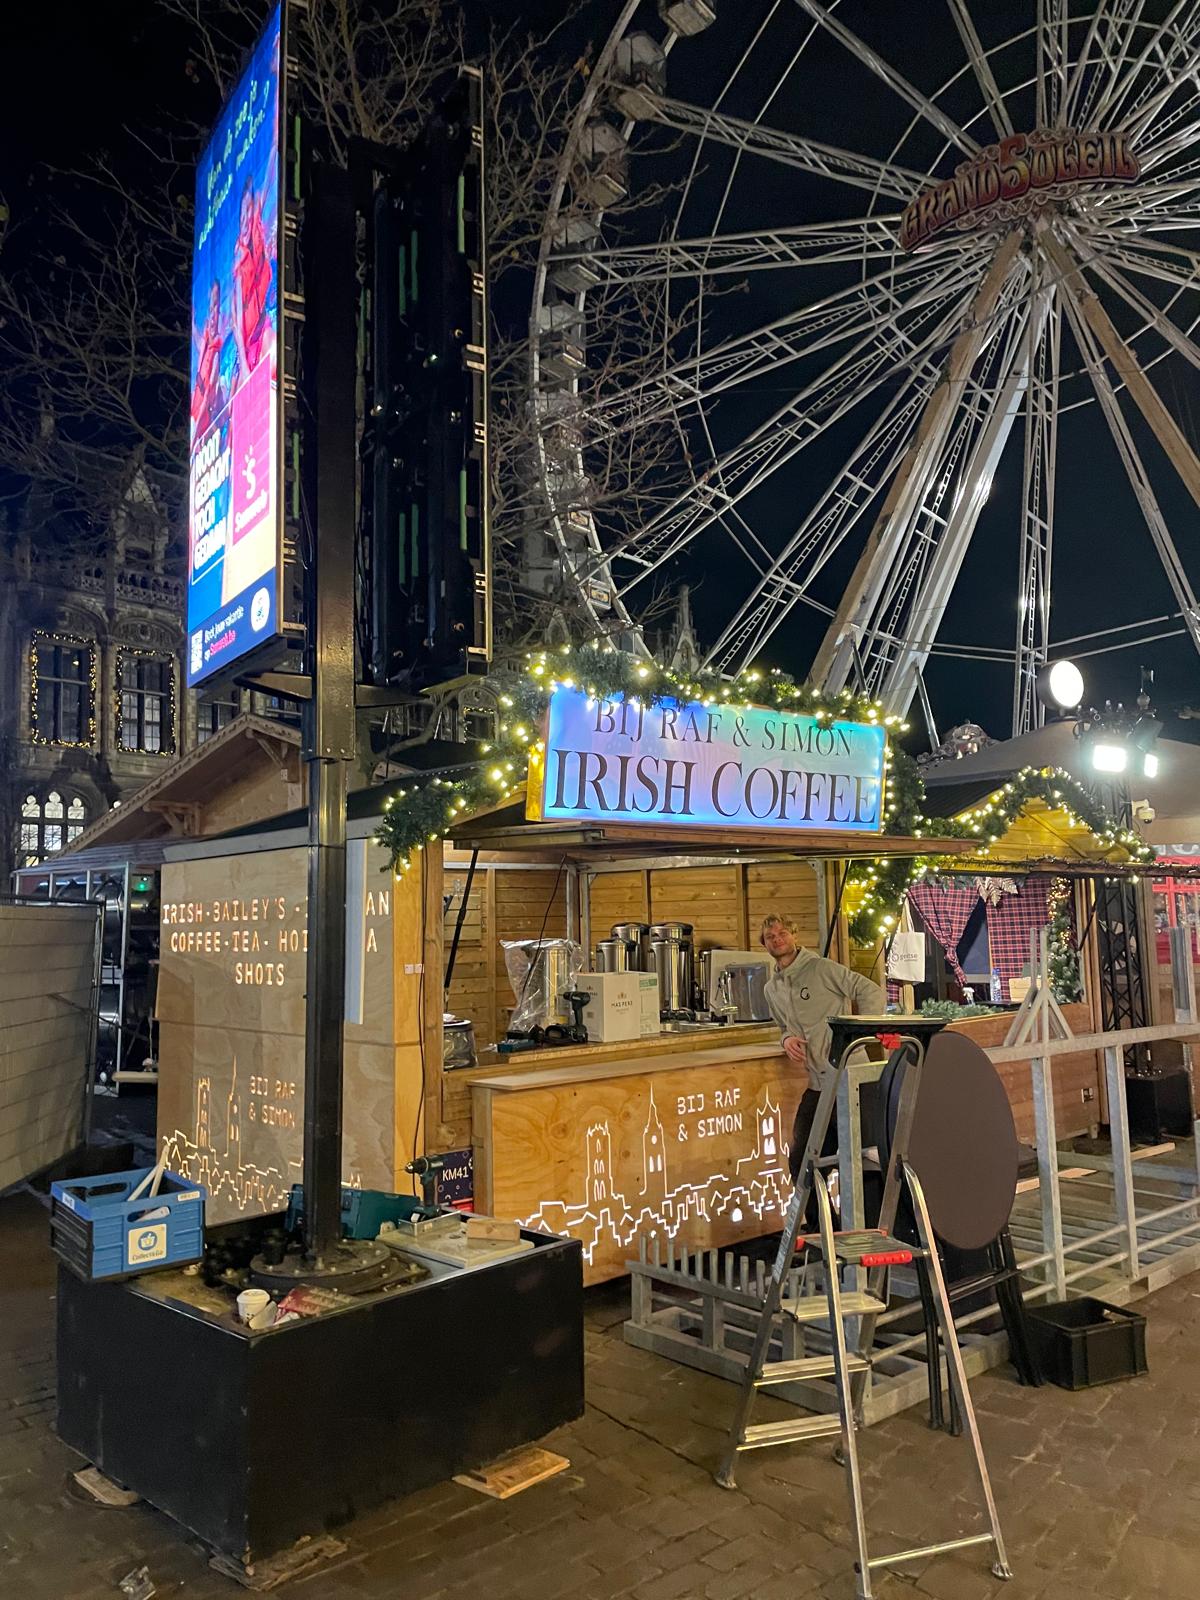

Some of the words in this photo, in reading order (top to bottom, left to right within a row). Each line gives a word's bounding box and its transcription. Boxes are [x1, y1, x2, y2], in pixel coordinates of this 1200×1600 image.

[900, 160, 1001, 251] GRAND
[1001, 133, 1141, 200] SOLEIL
[195, 428, 221, 482] NOOIT
[593, 699, 643, 742] BIJ
[659, 706, 724, 745] RAF
[732, 716, 752, 747] &
[761, 718, 855, 758] SIMON
[549, 748, 699, 816] IRISH
[710, 761, 877, 824] COFFEE
[235, 962, 286, 986] SHOTS
[262, 1104, 295, 1128] SIMON
[677, 1093, 705, 1115] BIJ
[714, 1087, 741, 1109] RAF
[678, 1123, 689, 1142] &
[697, 1112, 743, 1138] SIMON
[442, 1166, 469, 1182] KM41
